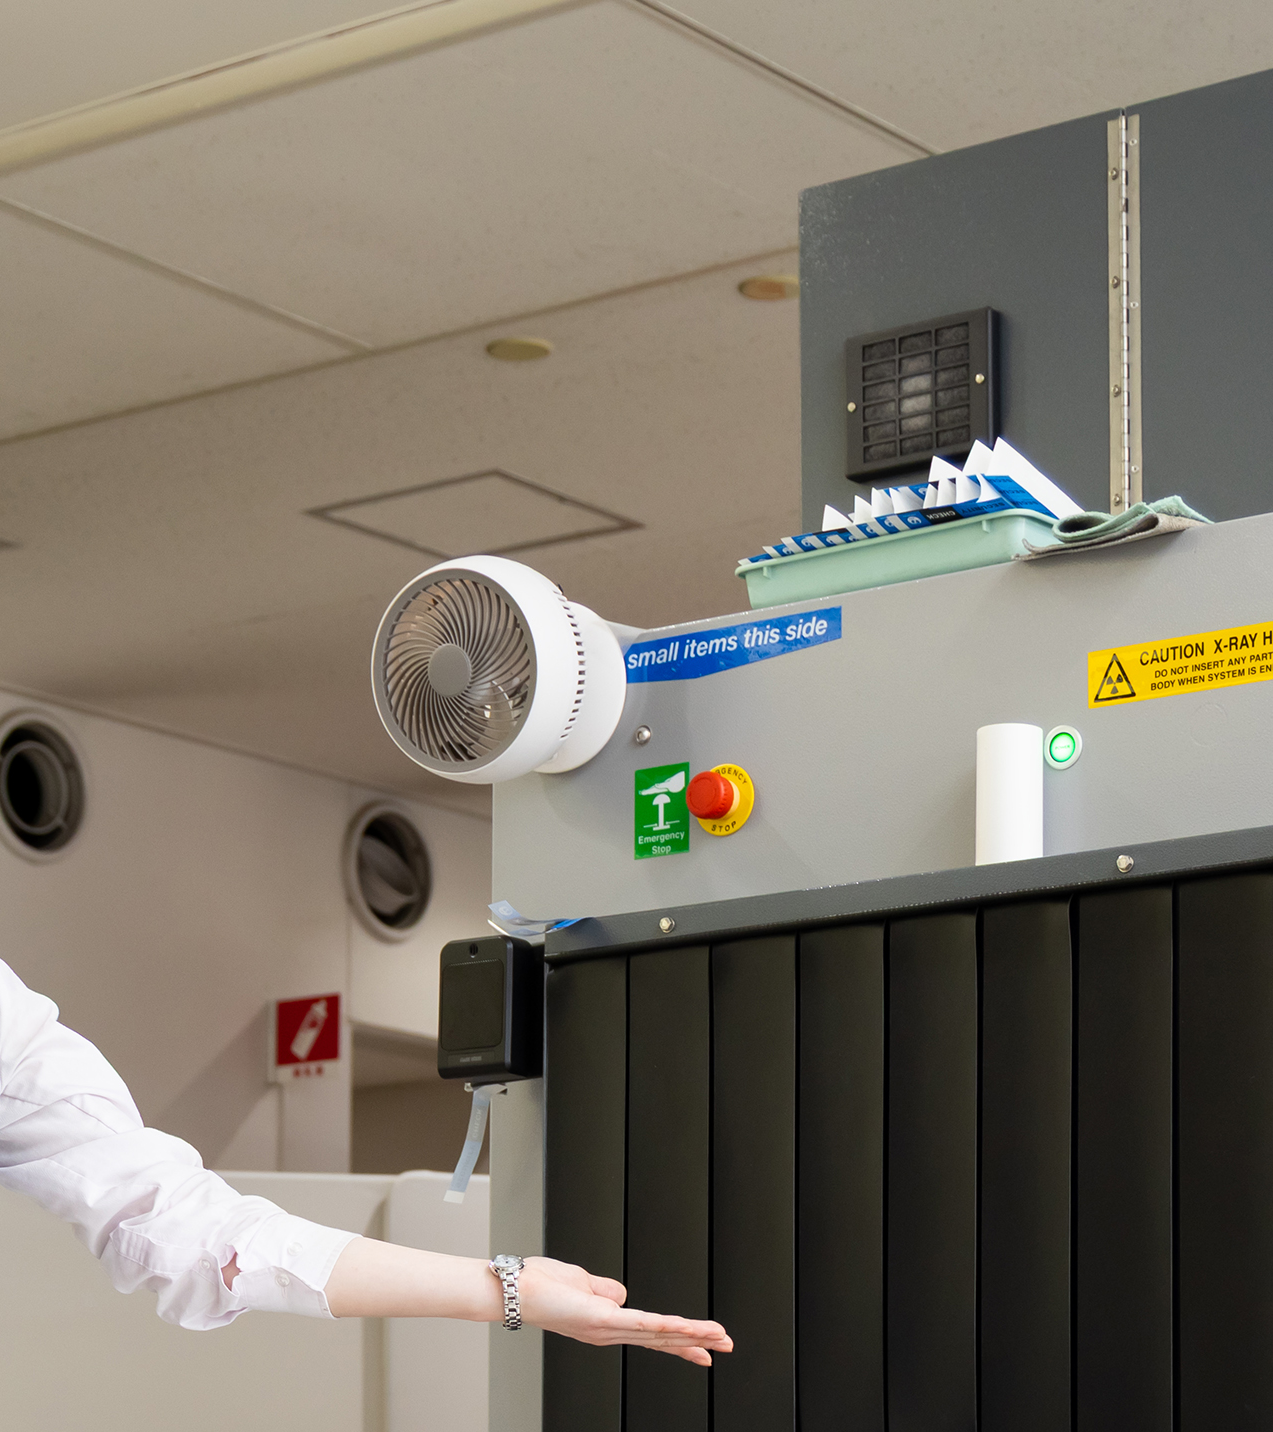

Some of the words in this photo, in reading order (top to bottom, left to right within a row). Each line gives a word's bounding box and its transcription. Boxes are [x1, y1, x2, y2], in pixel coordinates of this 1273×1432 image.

[926, 510, 956, 521] CHECK
[960, 502, 1006, 514] SECURITY
[627, 641, 680, 670] small
[683, 634, 738, 660] items
[743, 626, 780, 648] this
[785, 616, 828, 641] side
[1139, 641, 1205, 666] CAUTION
[1213, 632, 1258, 654] X-RAY
[1154, 668, 1168, 678] DO
[1170, 665, 1189, 676] NOT
[1191, 660, 1226, 674] INSERT
[1227, 656, 1248, 668] ANY
[1250, 652, 1273, 664] PART
[1150, 680, 1176, 692] BODY
[1178, 676, 1206, 688] WHEN
[1207, 669, 1246, 683] SYSTEM
[1248, 666, 1256, 676] IS
[711, 820, 737, 833] STOP
[638, 830, 685, 845] Emergency
[652, 845, 672, 855] Stop
